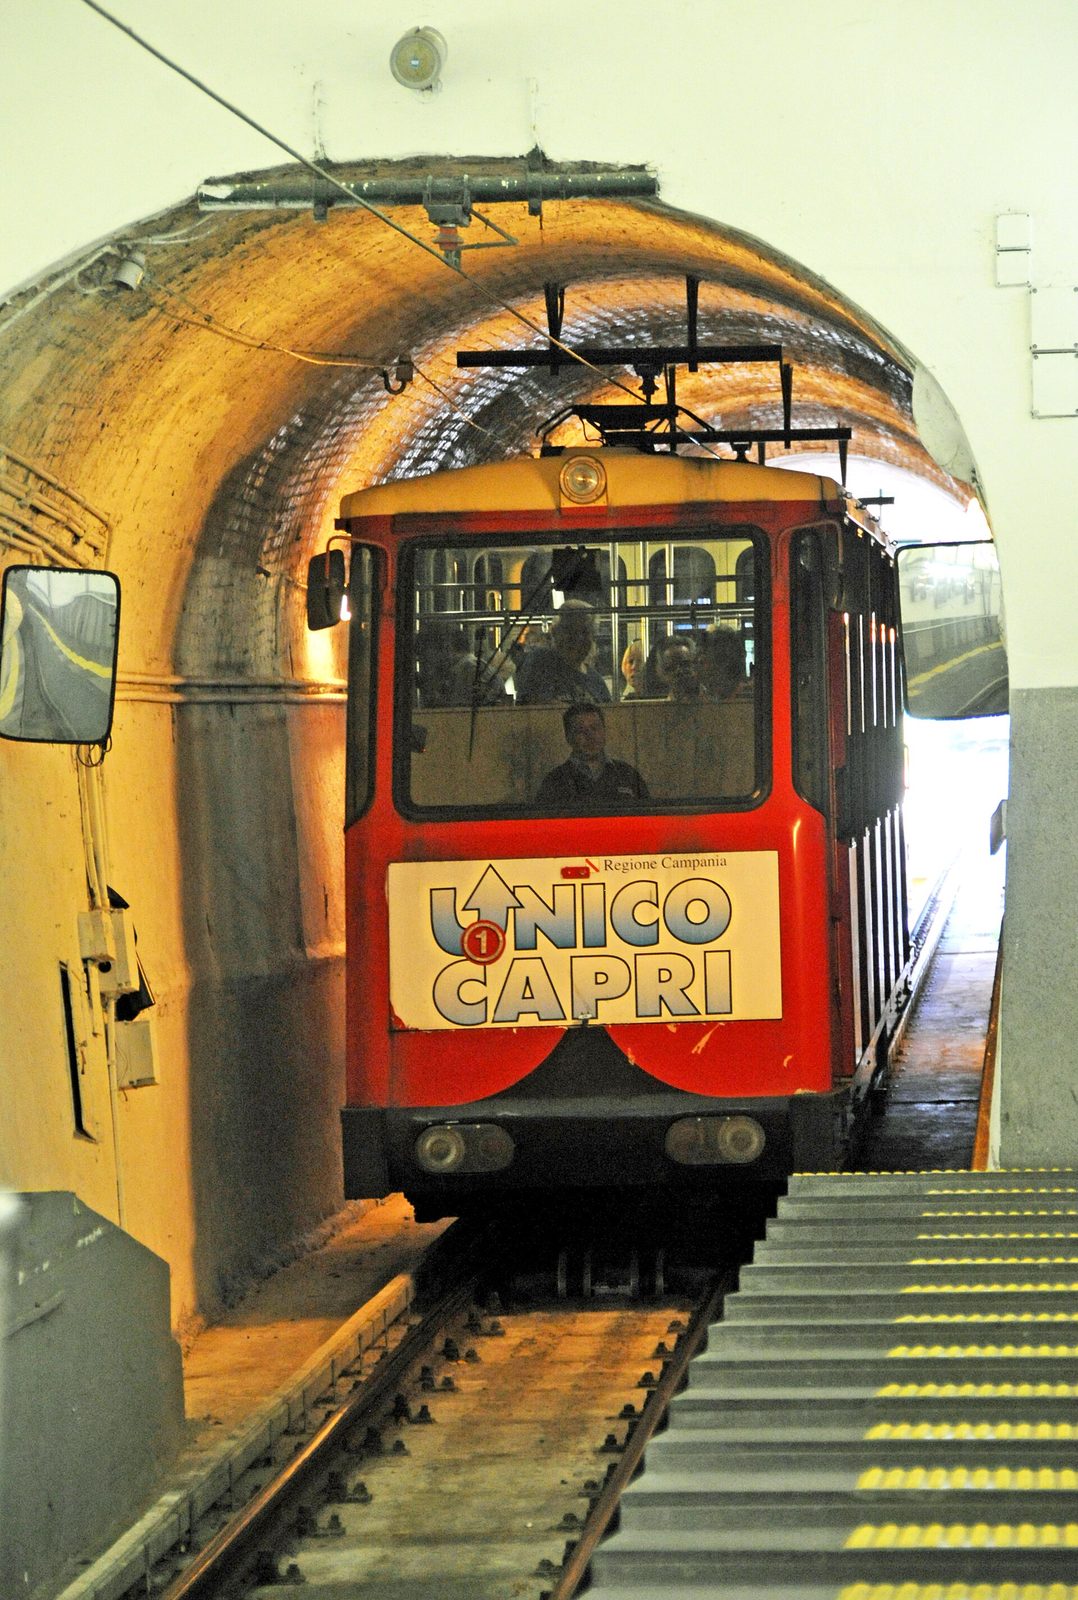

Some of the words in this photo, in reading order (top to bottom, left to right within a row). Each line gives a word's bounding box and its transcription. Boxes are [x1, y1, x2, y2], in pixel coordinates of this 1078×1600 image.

[604, 859, 658, 873] Regione
[661, 855, 727, 871] Campania
[430, 864, 733, 956] UNICO
[475, 930, 488, 954] 1
[432, 950, 734, 1026] CAPRI
